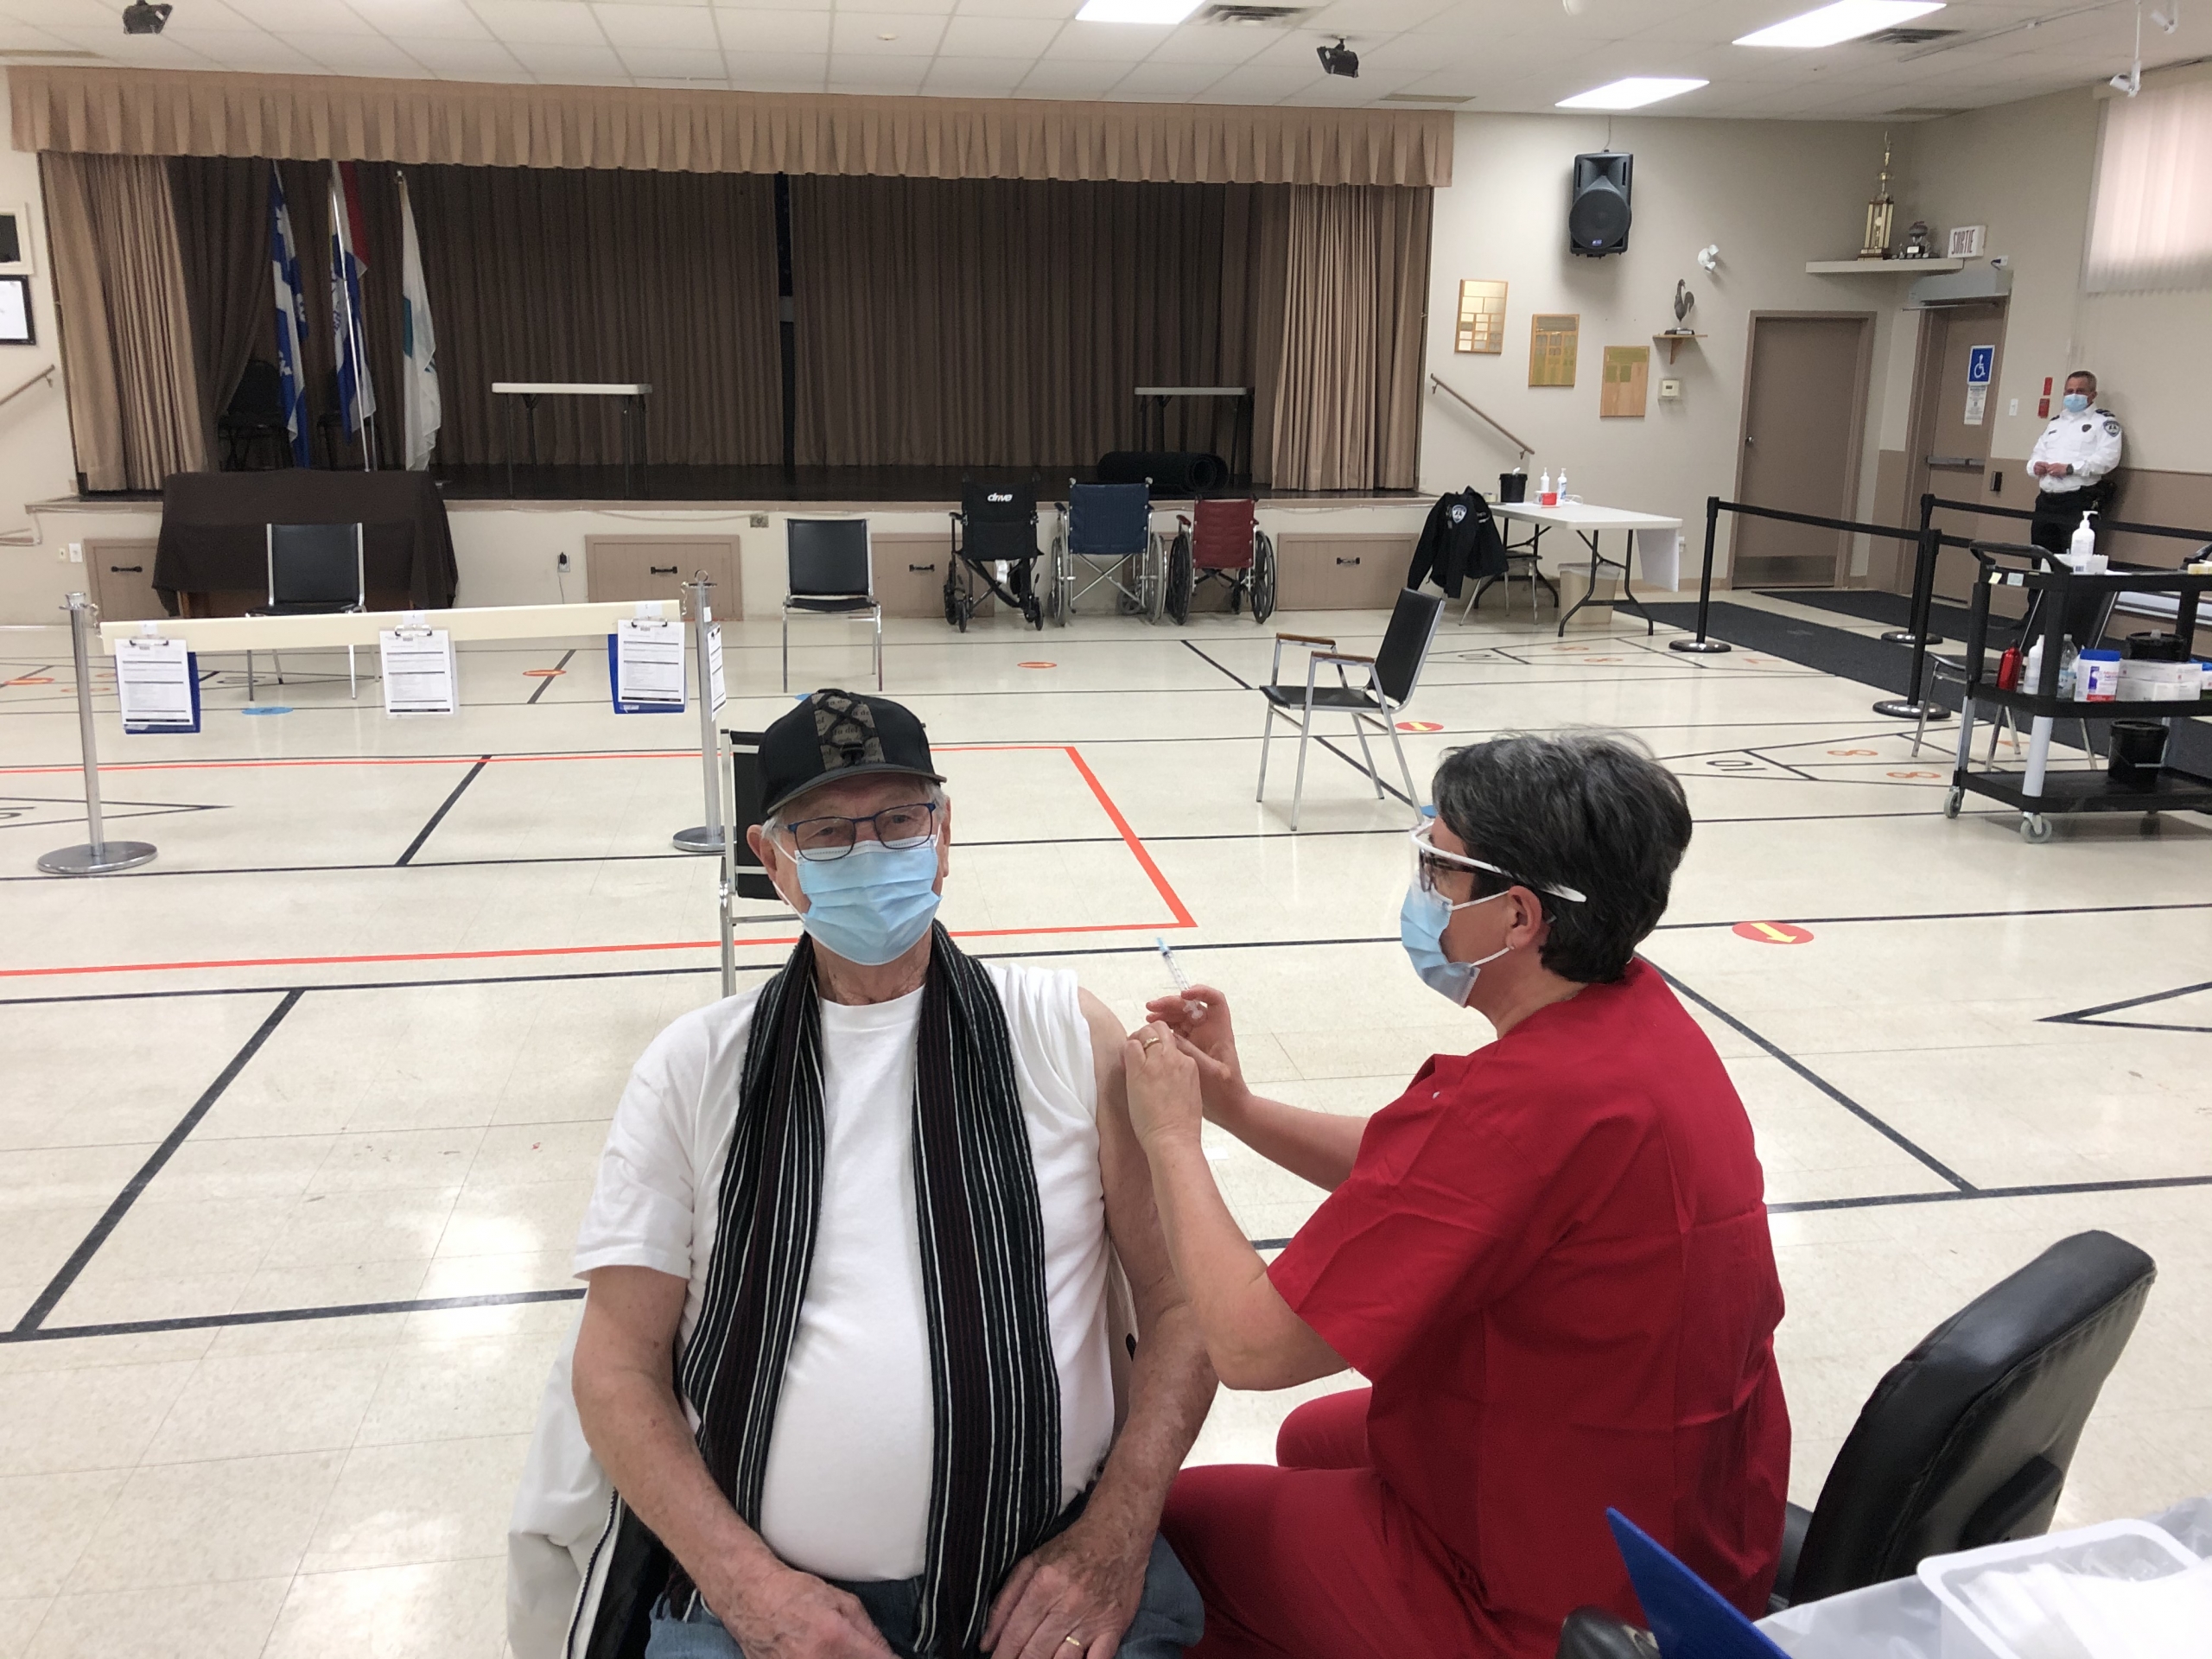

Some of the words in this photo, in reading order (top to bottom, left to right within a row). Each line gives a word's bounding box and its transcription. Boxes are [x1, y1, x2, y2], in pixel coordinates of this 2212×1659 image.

[1951, 229, 1975, 254] SORTIE
[987, 493, 1014, 502] drive
[1827, 748, 1878, 757] 8
[1706, 759, 1768, 772] 10
